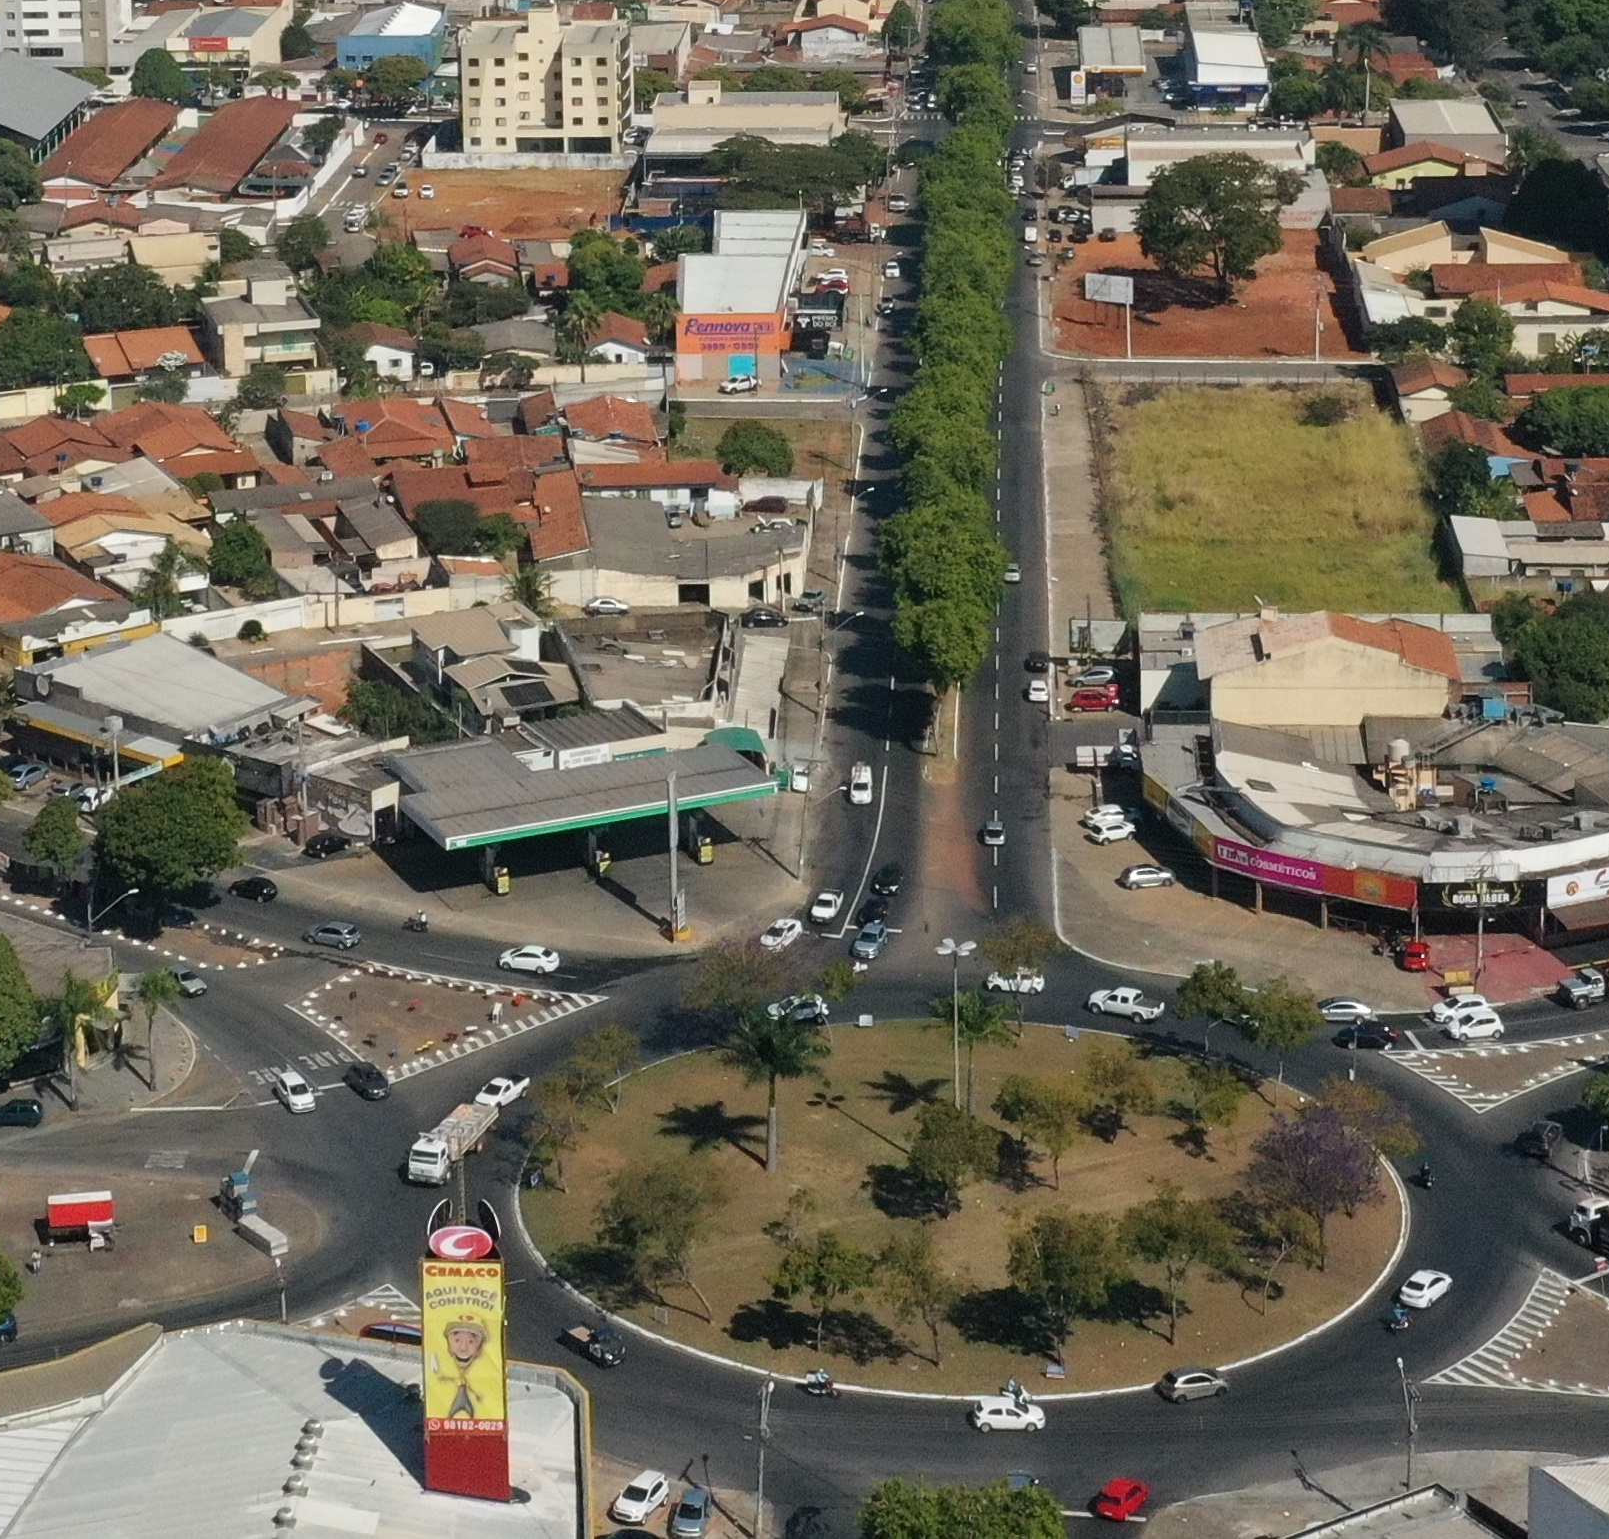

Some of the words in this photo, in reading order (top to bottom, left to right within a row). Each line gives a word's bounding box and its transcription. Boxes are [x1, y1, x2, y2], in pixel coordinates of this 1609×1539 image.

[685, 318, 751, 336] Rennova
[1250, 855, 1317, 880] COSMÉTICOS
[425, 1265, 499, 1278] CEMACO
[425, 1286, 458, 1300] AQUI
